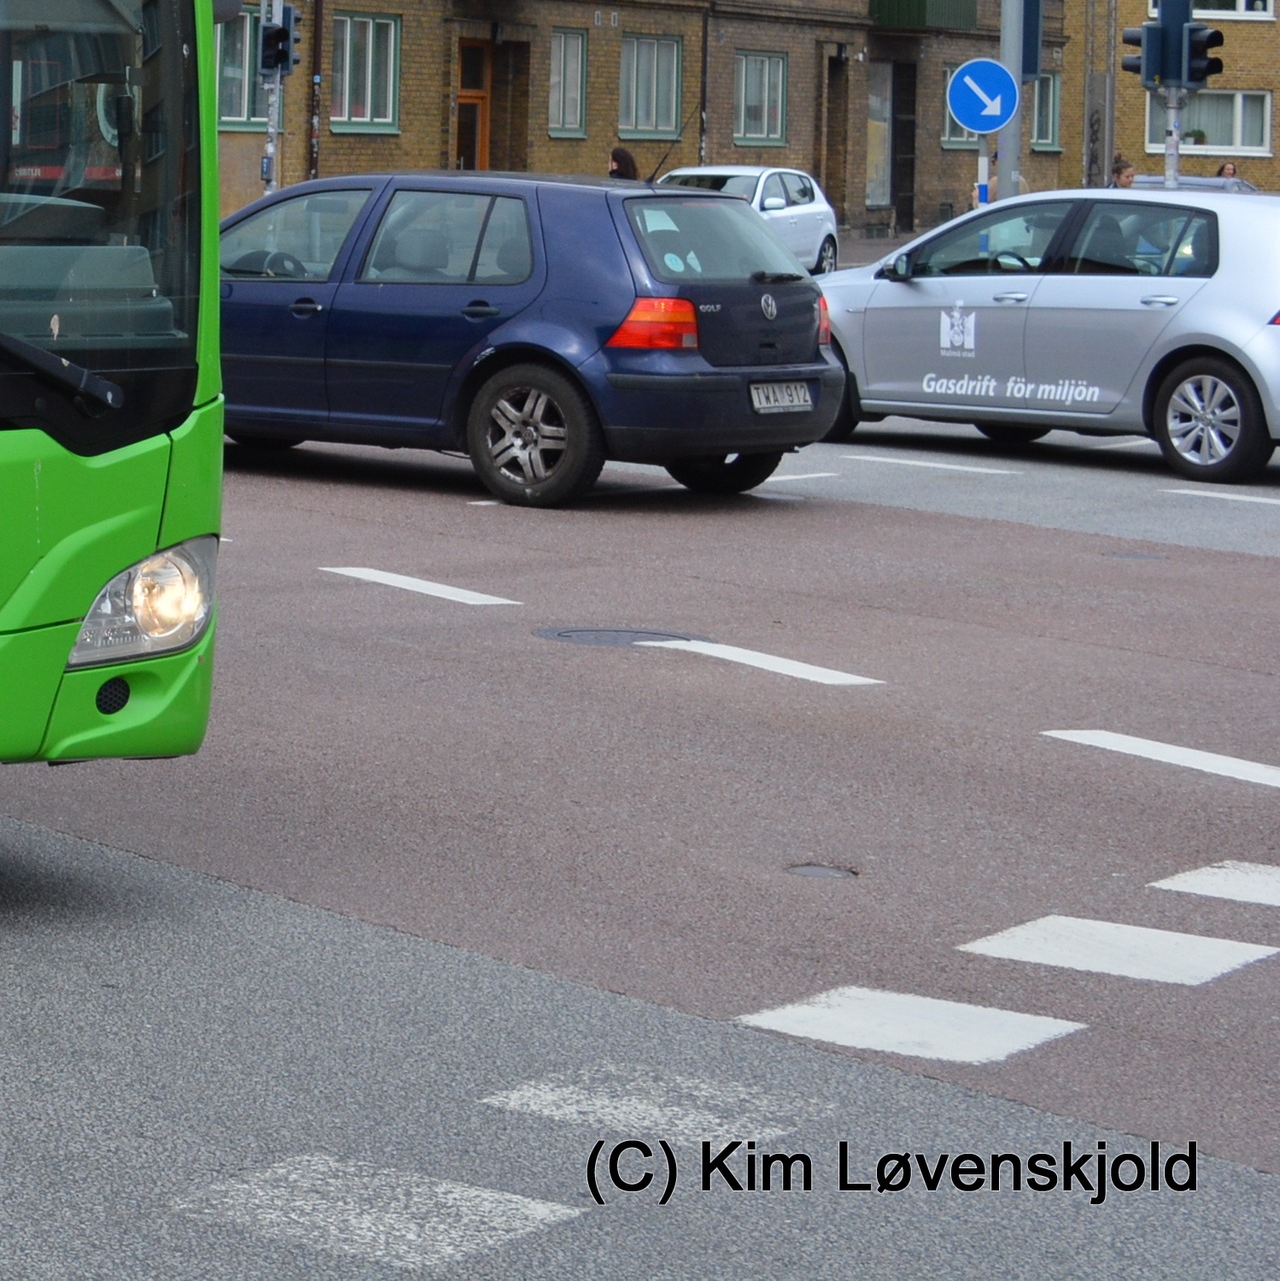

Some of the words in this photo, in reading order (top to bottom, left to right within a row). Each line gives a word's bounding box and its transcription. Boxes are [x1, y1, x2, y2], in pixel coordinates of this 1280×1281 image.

[699, 304, 722, 313] GOLF
[753, 386, 781, 406] TWA
[784, 385, 809, 404] 912
[922, 372, 998, 397] Gasdrift
[1005, 375, 1035, 400] för
[1037, 379, 1100, 406] miljön
